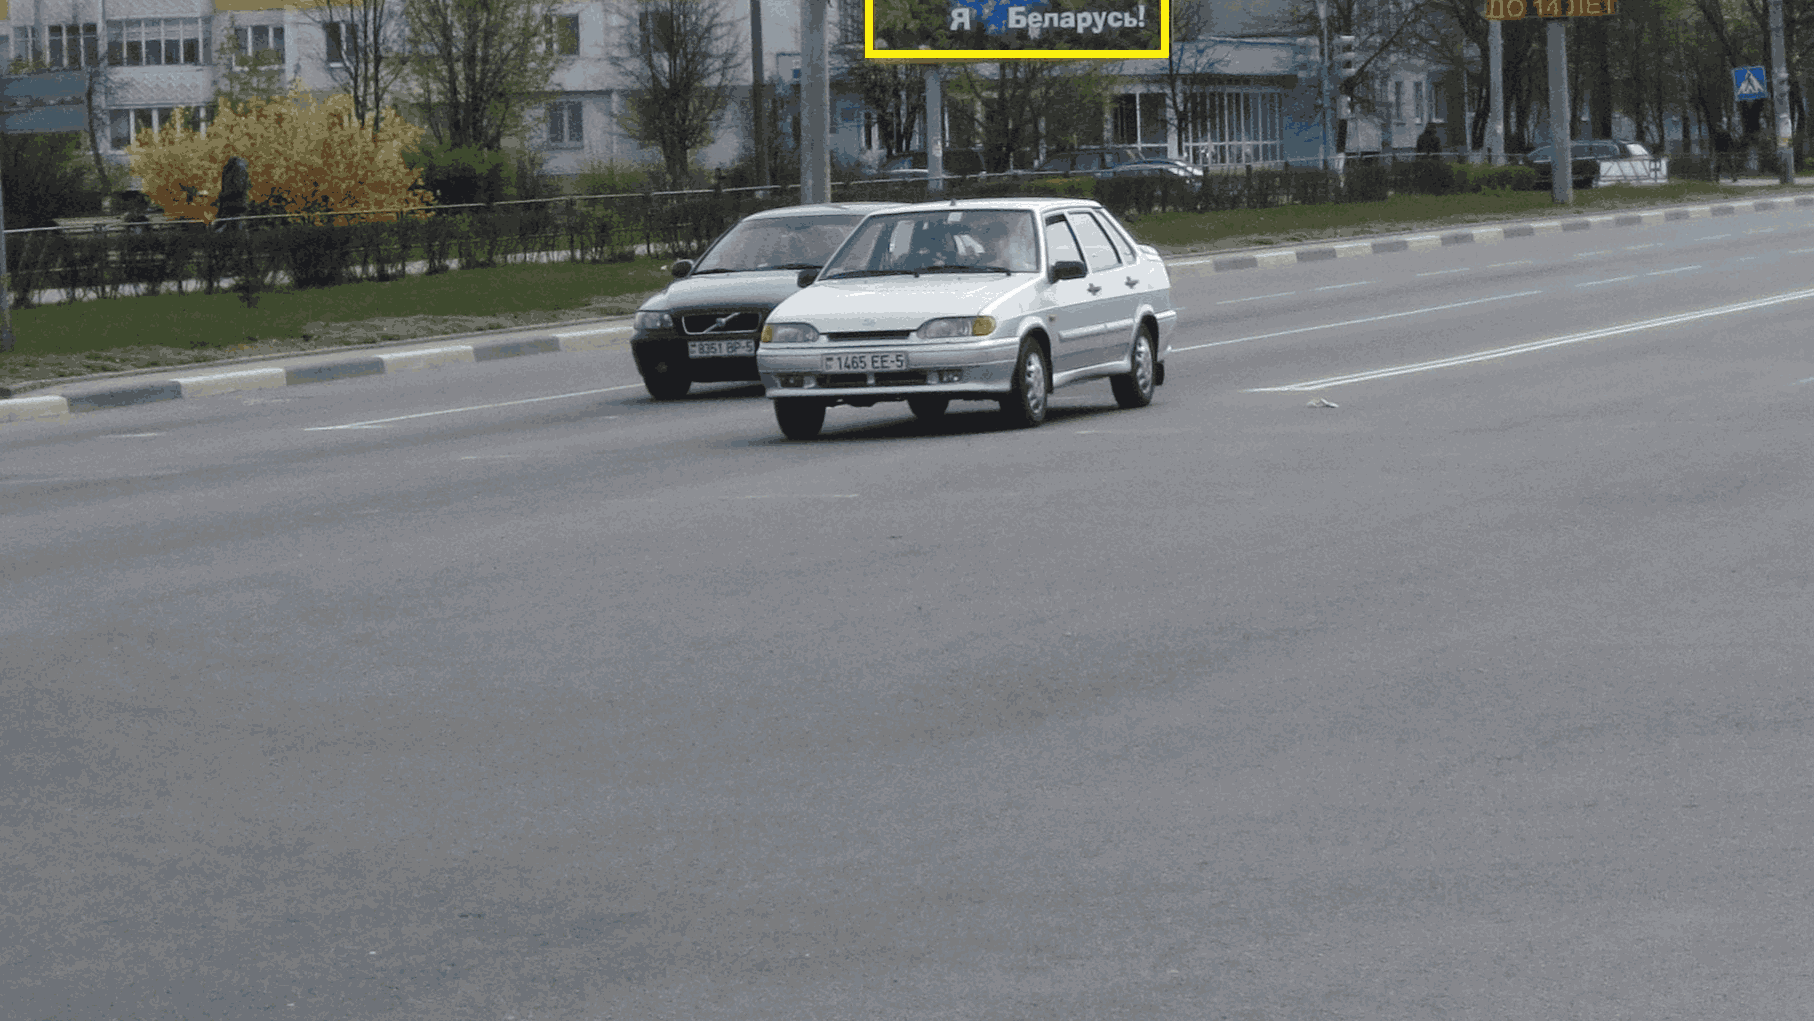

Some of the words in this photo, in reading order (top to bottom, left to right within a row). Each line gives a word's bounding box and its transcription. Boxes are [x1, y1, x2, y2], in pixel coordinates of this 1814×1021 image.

[950, 7, 971, 30] Я
[1008, 5, 1146, 33] Беларусь!
[837, 355, 867, 370] 1465
[871, 353, 904, 369] EE-5
